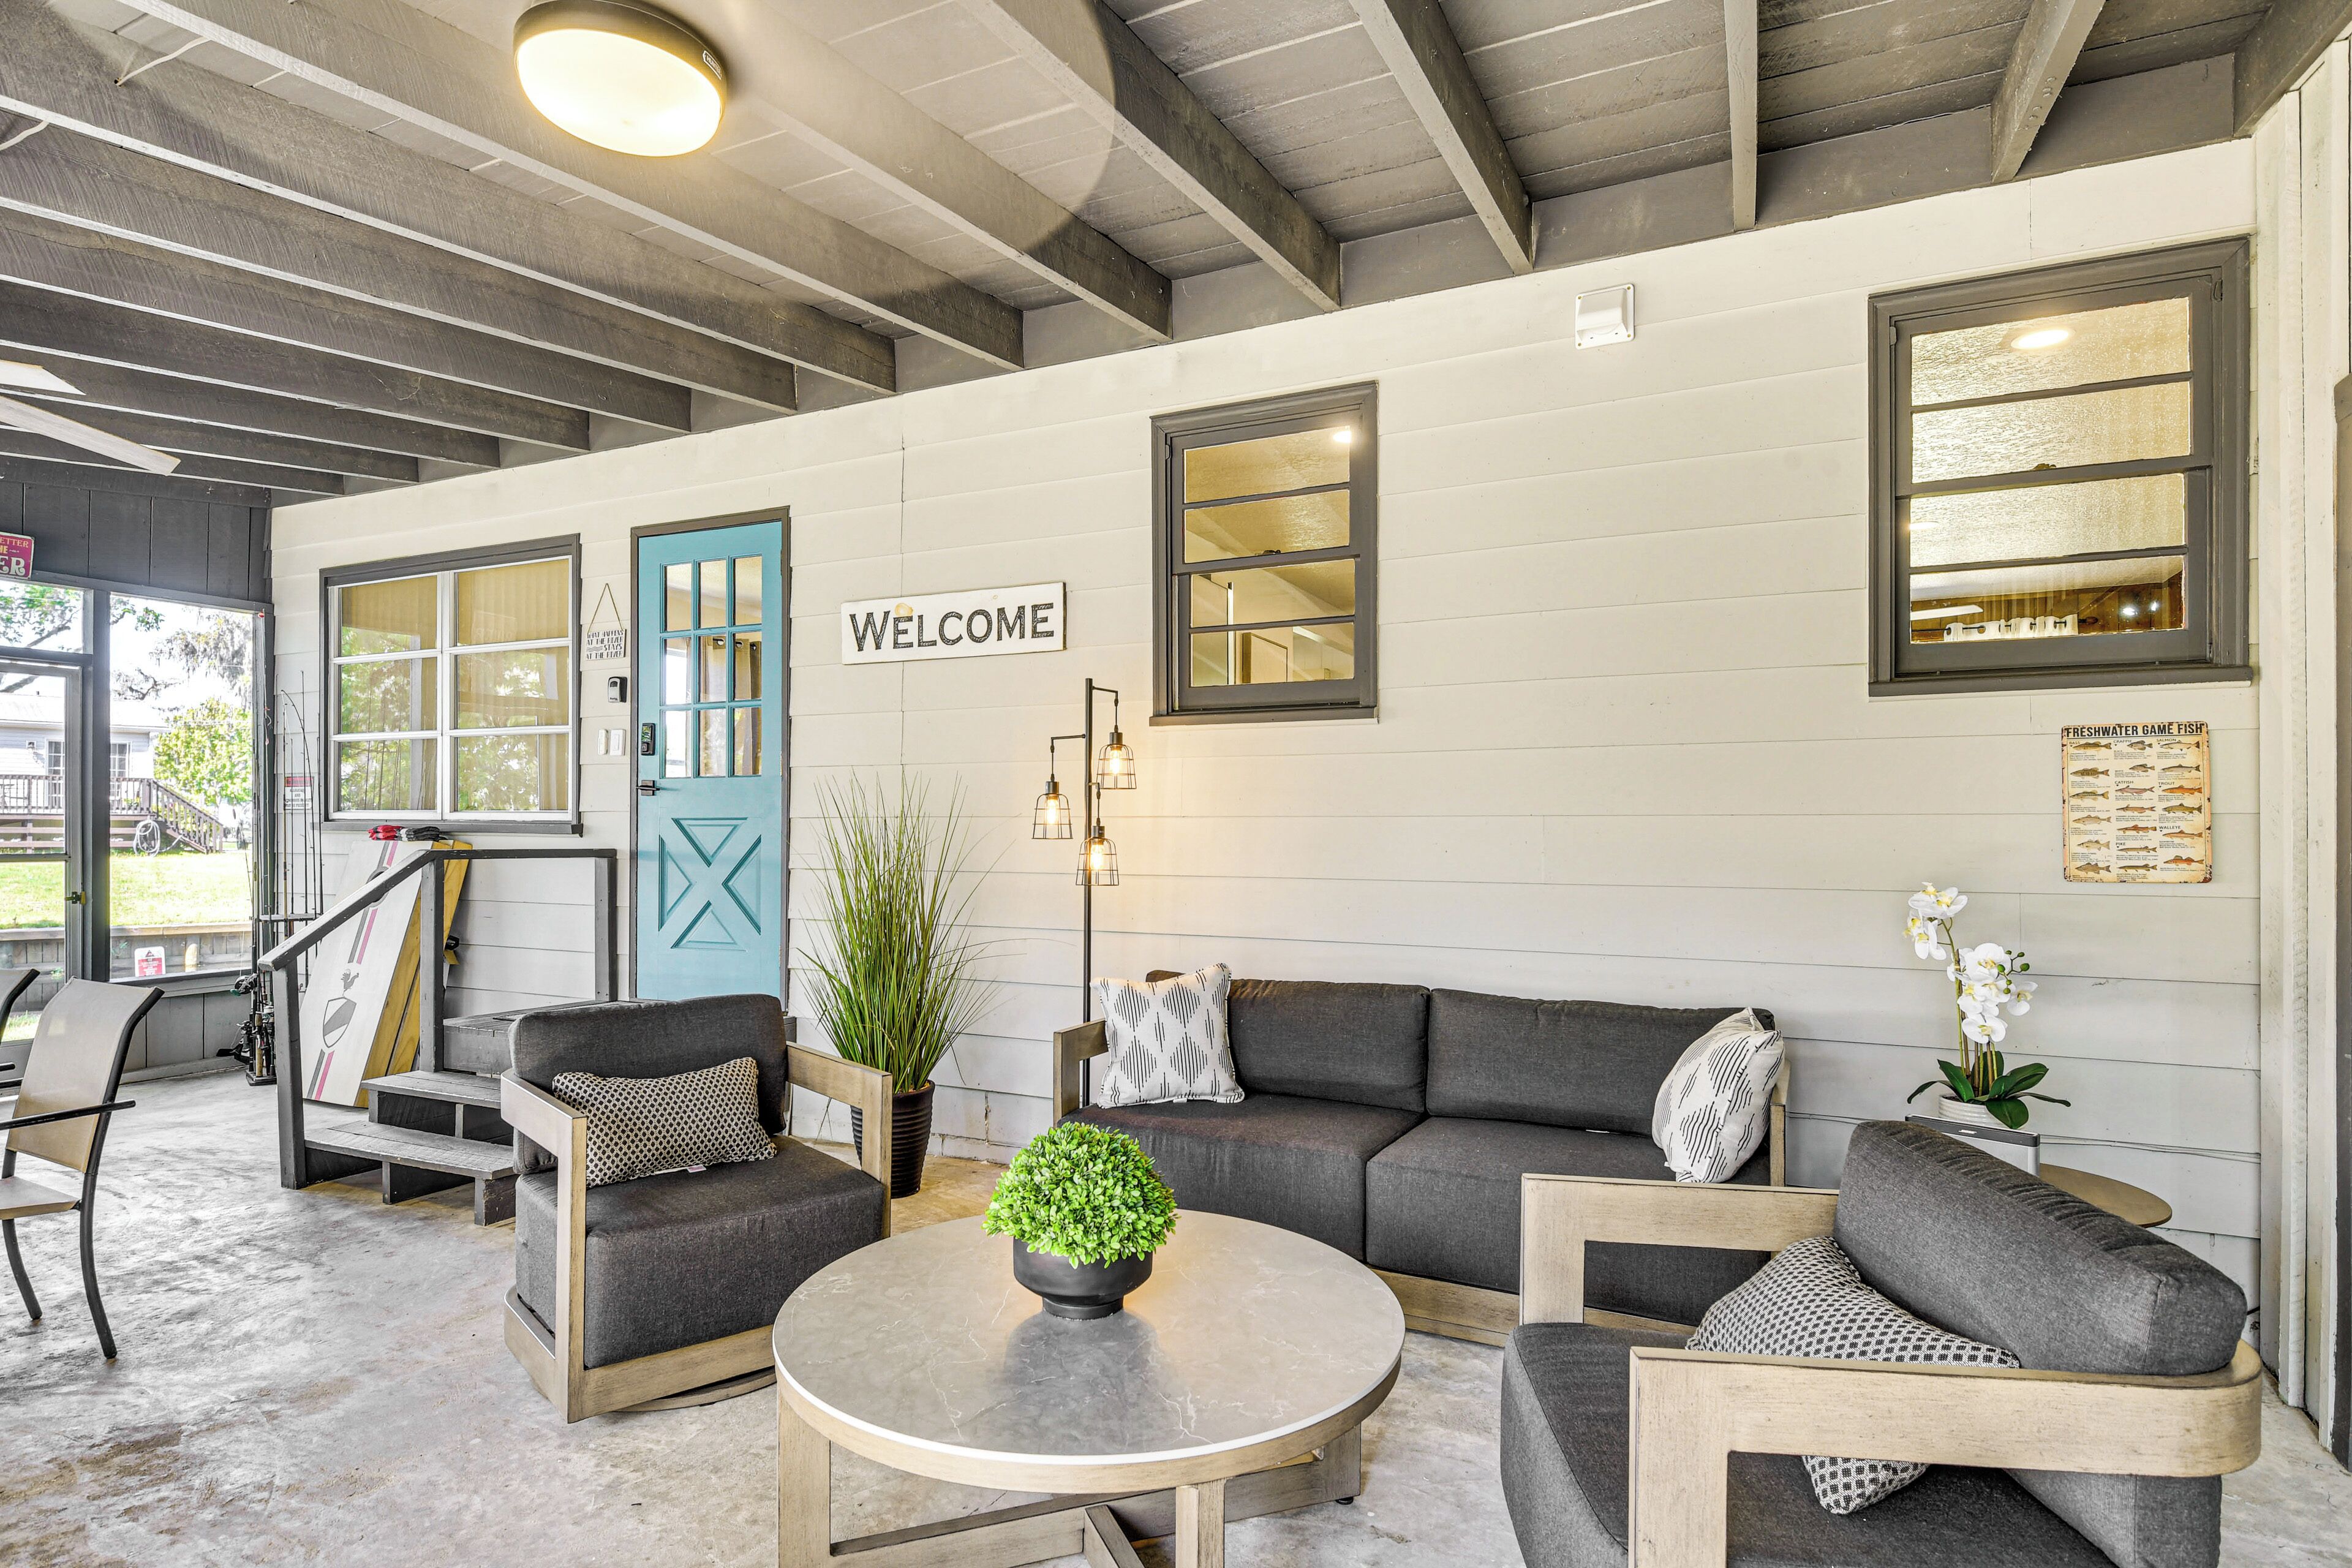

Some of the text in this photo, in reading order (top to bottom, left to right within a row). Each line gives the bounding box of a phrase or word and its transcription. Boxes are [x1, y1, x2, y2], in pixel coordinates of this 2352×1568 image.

[849, 603, 1054, 652] WELCOME
[2067, 723, 2203, 737] FRESHWATER GAME FISH
